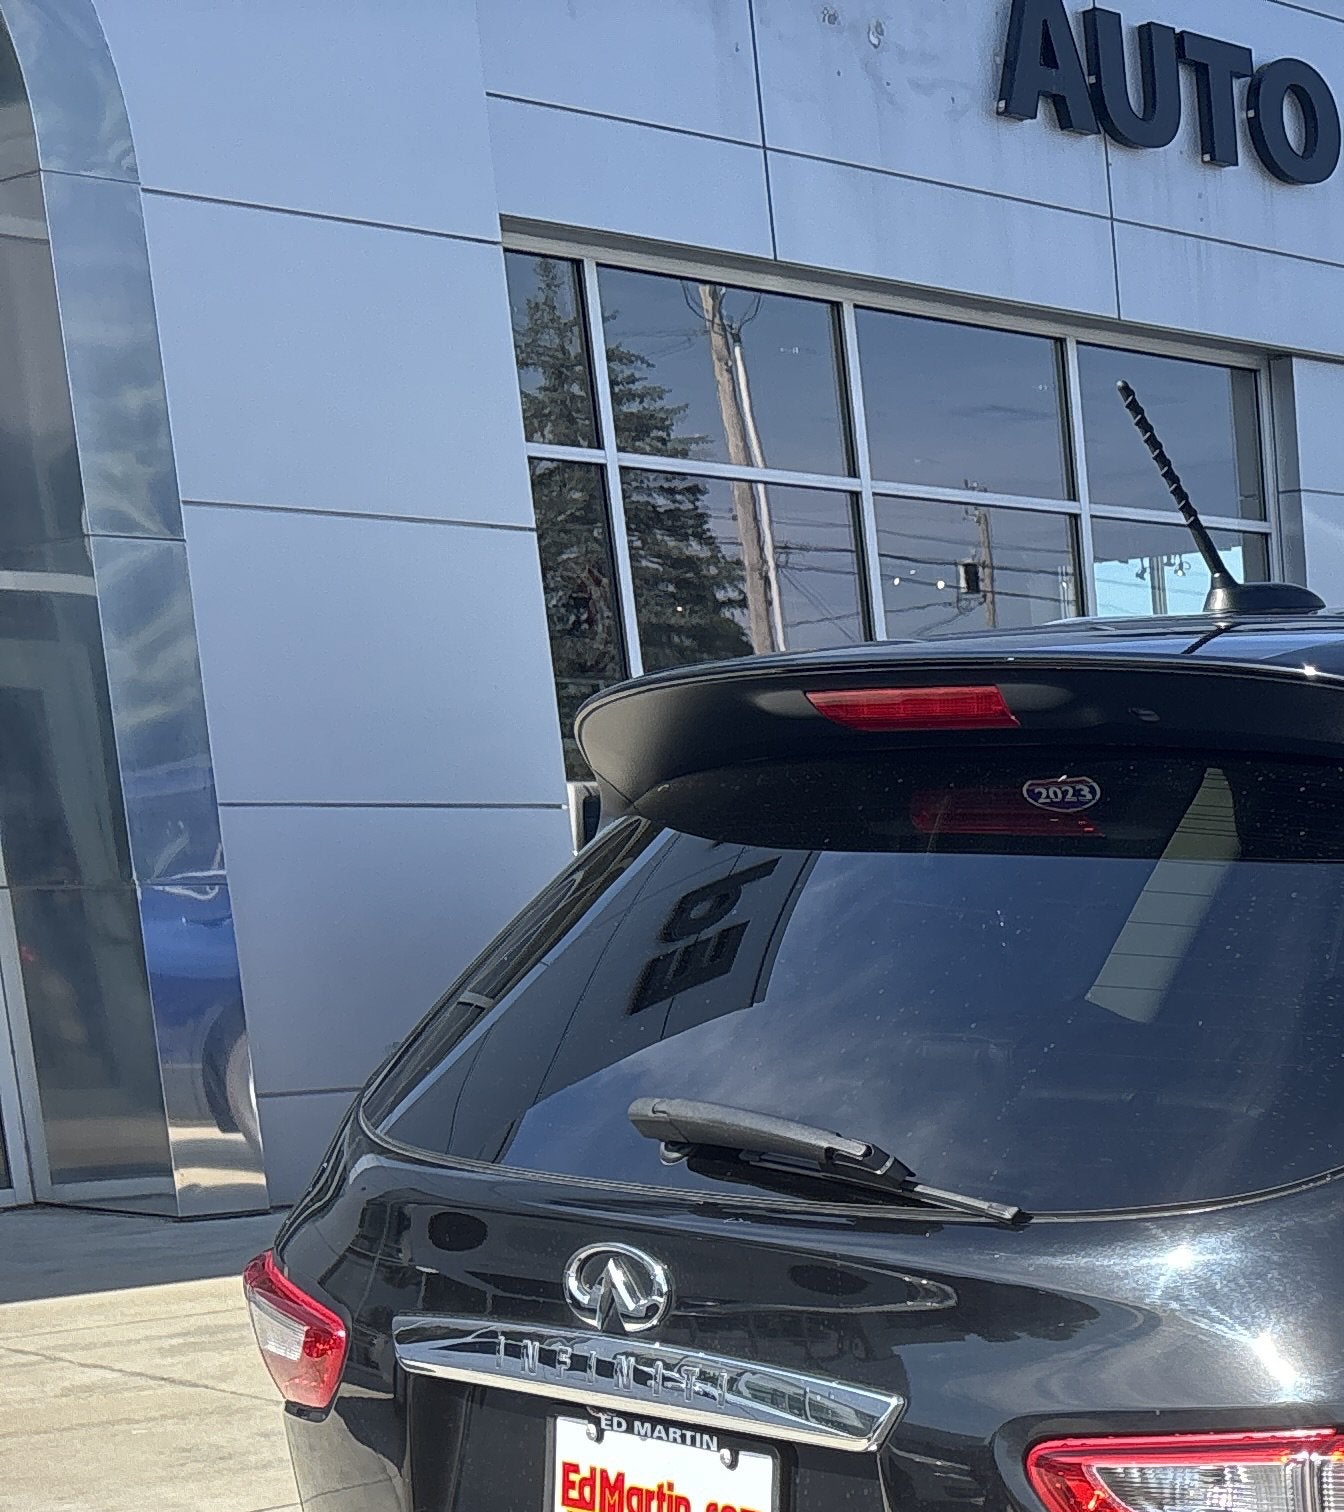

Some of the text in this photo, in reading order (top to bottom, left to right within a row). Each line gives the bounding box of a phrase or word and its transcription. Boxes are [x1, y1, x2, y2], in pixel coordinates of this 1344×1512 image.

[997, 0, 1341, 185] AUTO
[1034, 784, 1093, 803] 2023
[495, 1336, 729, 1409] INFINITI
[600, 1416, 719, 1450] ED MARTIN
